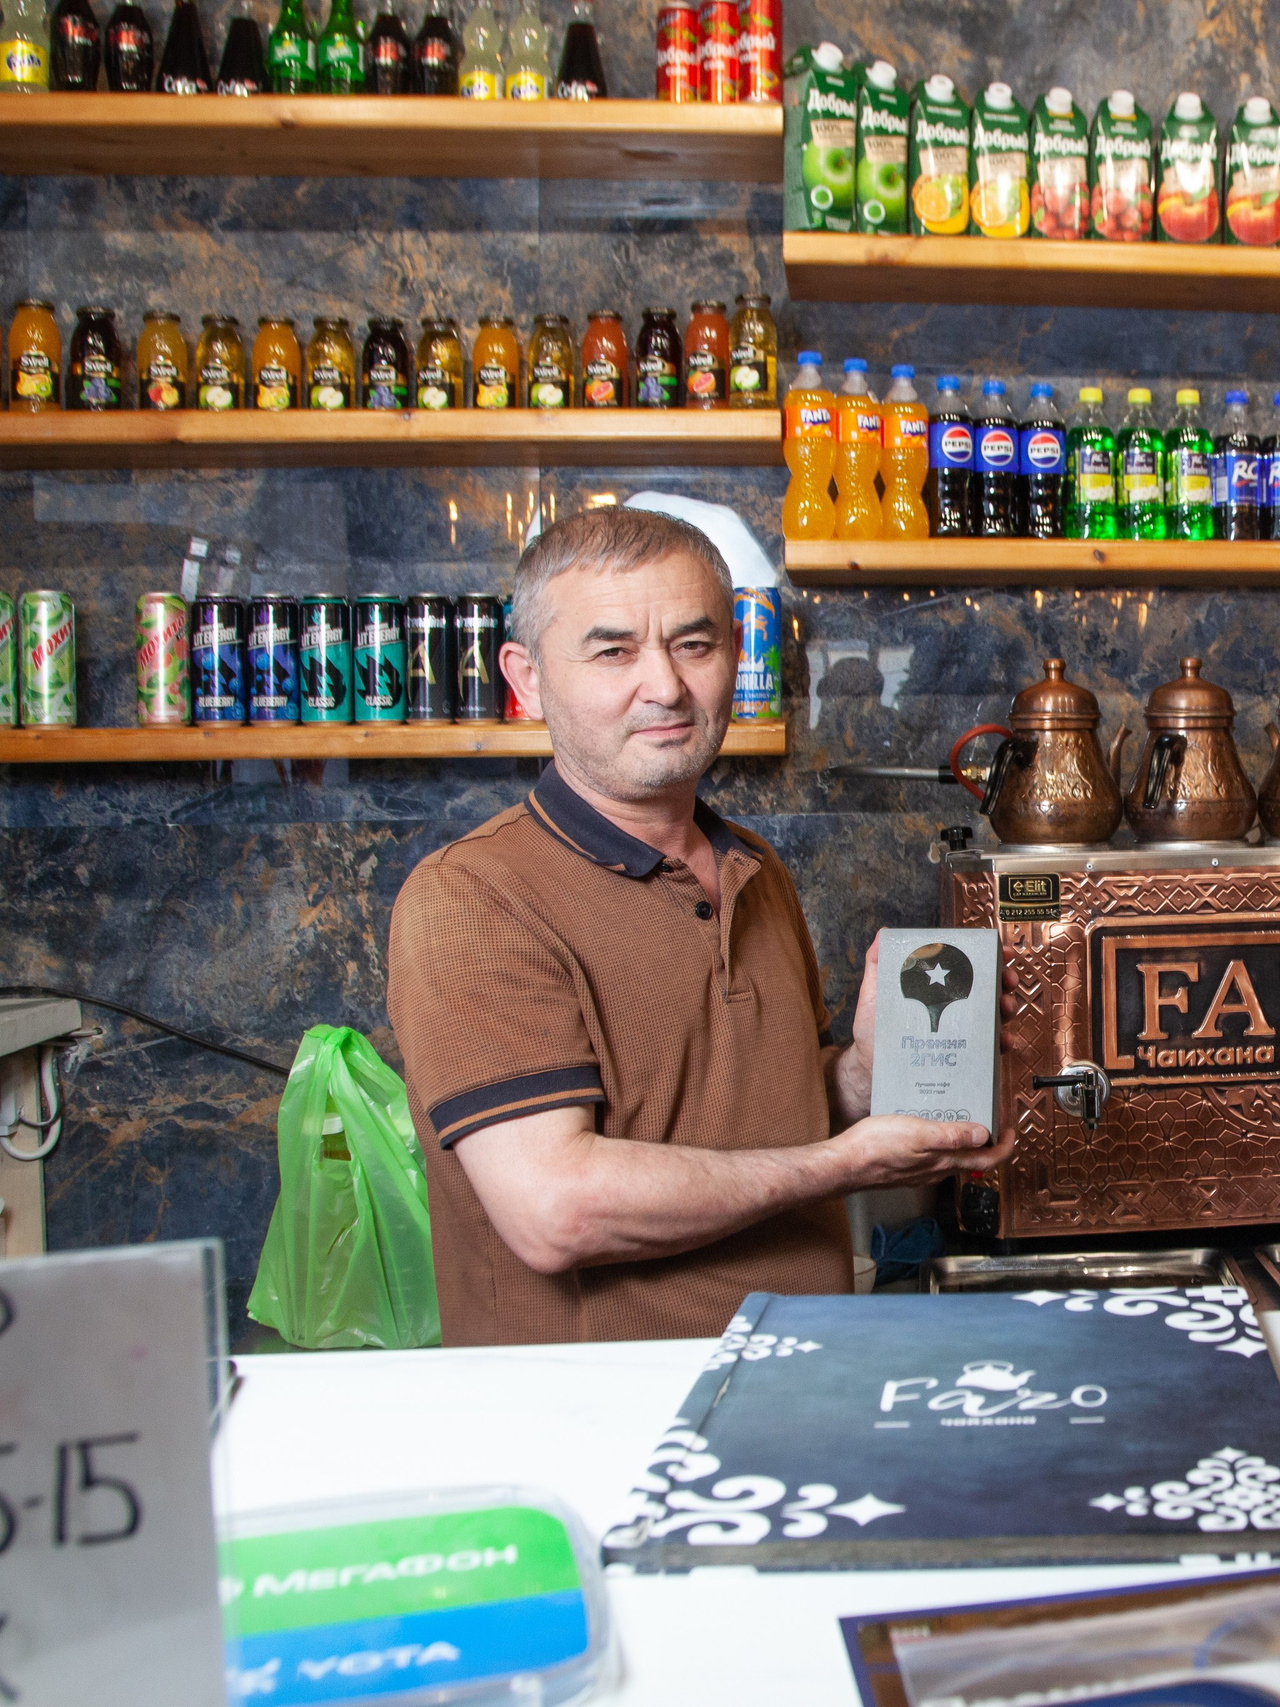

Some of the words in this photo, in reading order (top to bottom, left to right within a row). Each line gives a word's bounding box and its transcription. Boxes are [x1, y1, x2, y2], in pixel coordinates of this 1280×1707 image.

[944, 441, 971, 449] PEPSI
[983, 445, 1012, 453] PEPSI
[1030, 447, 1059, 455] PEPSI
[1231, 460, 1258, 487] RC
[735, 673, 774, 691] ORILLA
[199, 695, 235, 708] BLUEBERRY
[252, 695, 288, 708] BLUEBERRY
[307, 696, 335, 708] CLASSIC
[364, 695, 393, 707] CLASSIC
[1025, 879, 1047, 893] Elit
[1011, 908, 1023, 916] 212
[901, 1035, 967, 1053] Премия
[909, 1052, 957, 1068] 2ГИС
[879, 1375, 1108, 1418] Fazo
